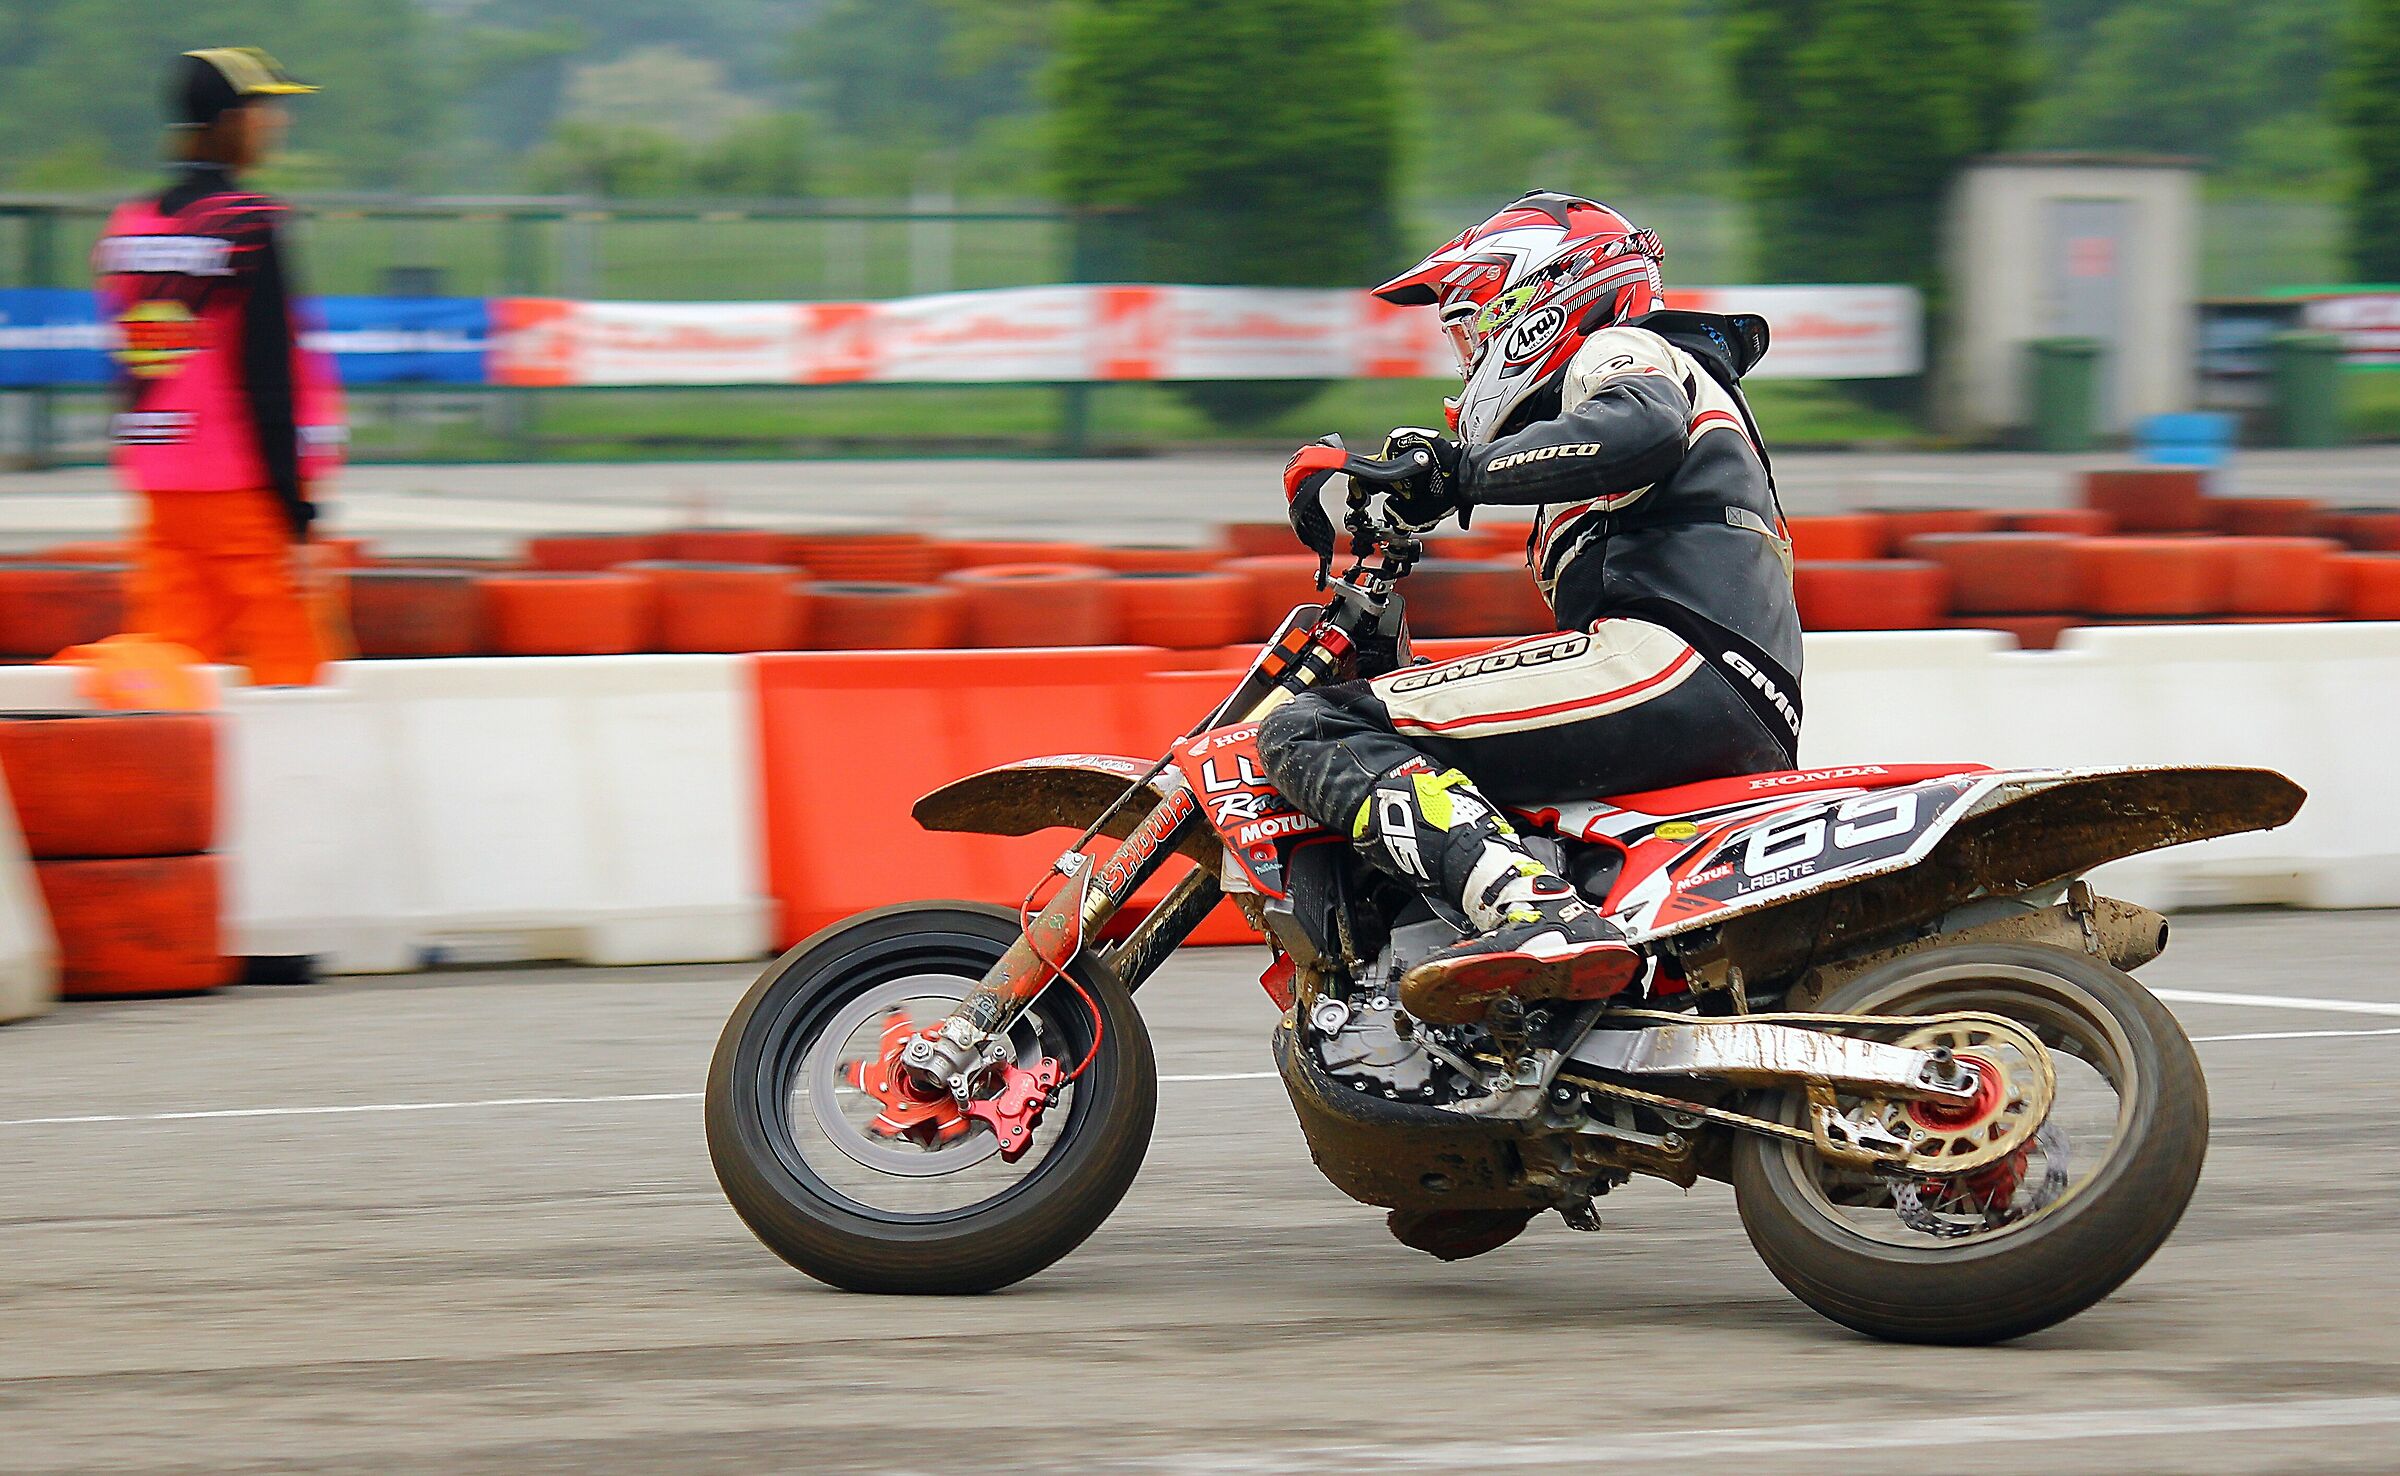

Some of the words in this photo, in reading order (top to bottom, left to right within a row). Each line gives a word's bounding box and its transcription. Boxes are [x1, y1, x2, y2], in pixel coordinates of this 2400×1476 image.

[1513, 307, 1557, 359] Arai
[1749, 765, 1888, 790] HONDA
[1240, 814, 1319, 845] MOTUL
[1676, 864, 1731, 890] MOTUL
